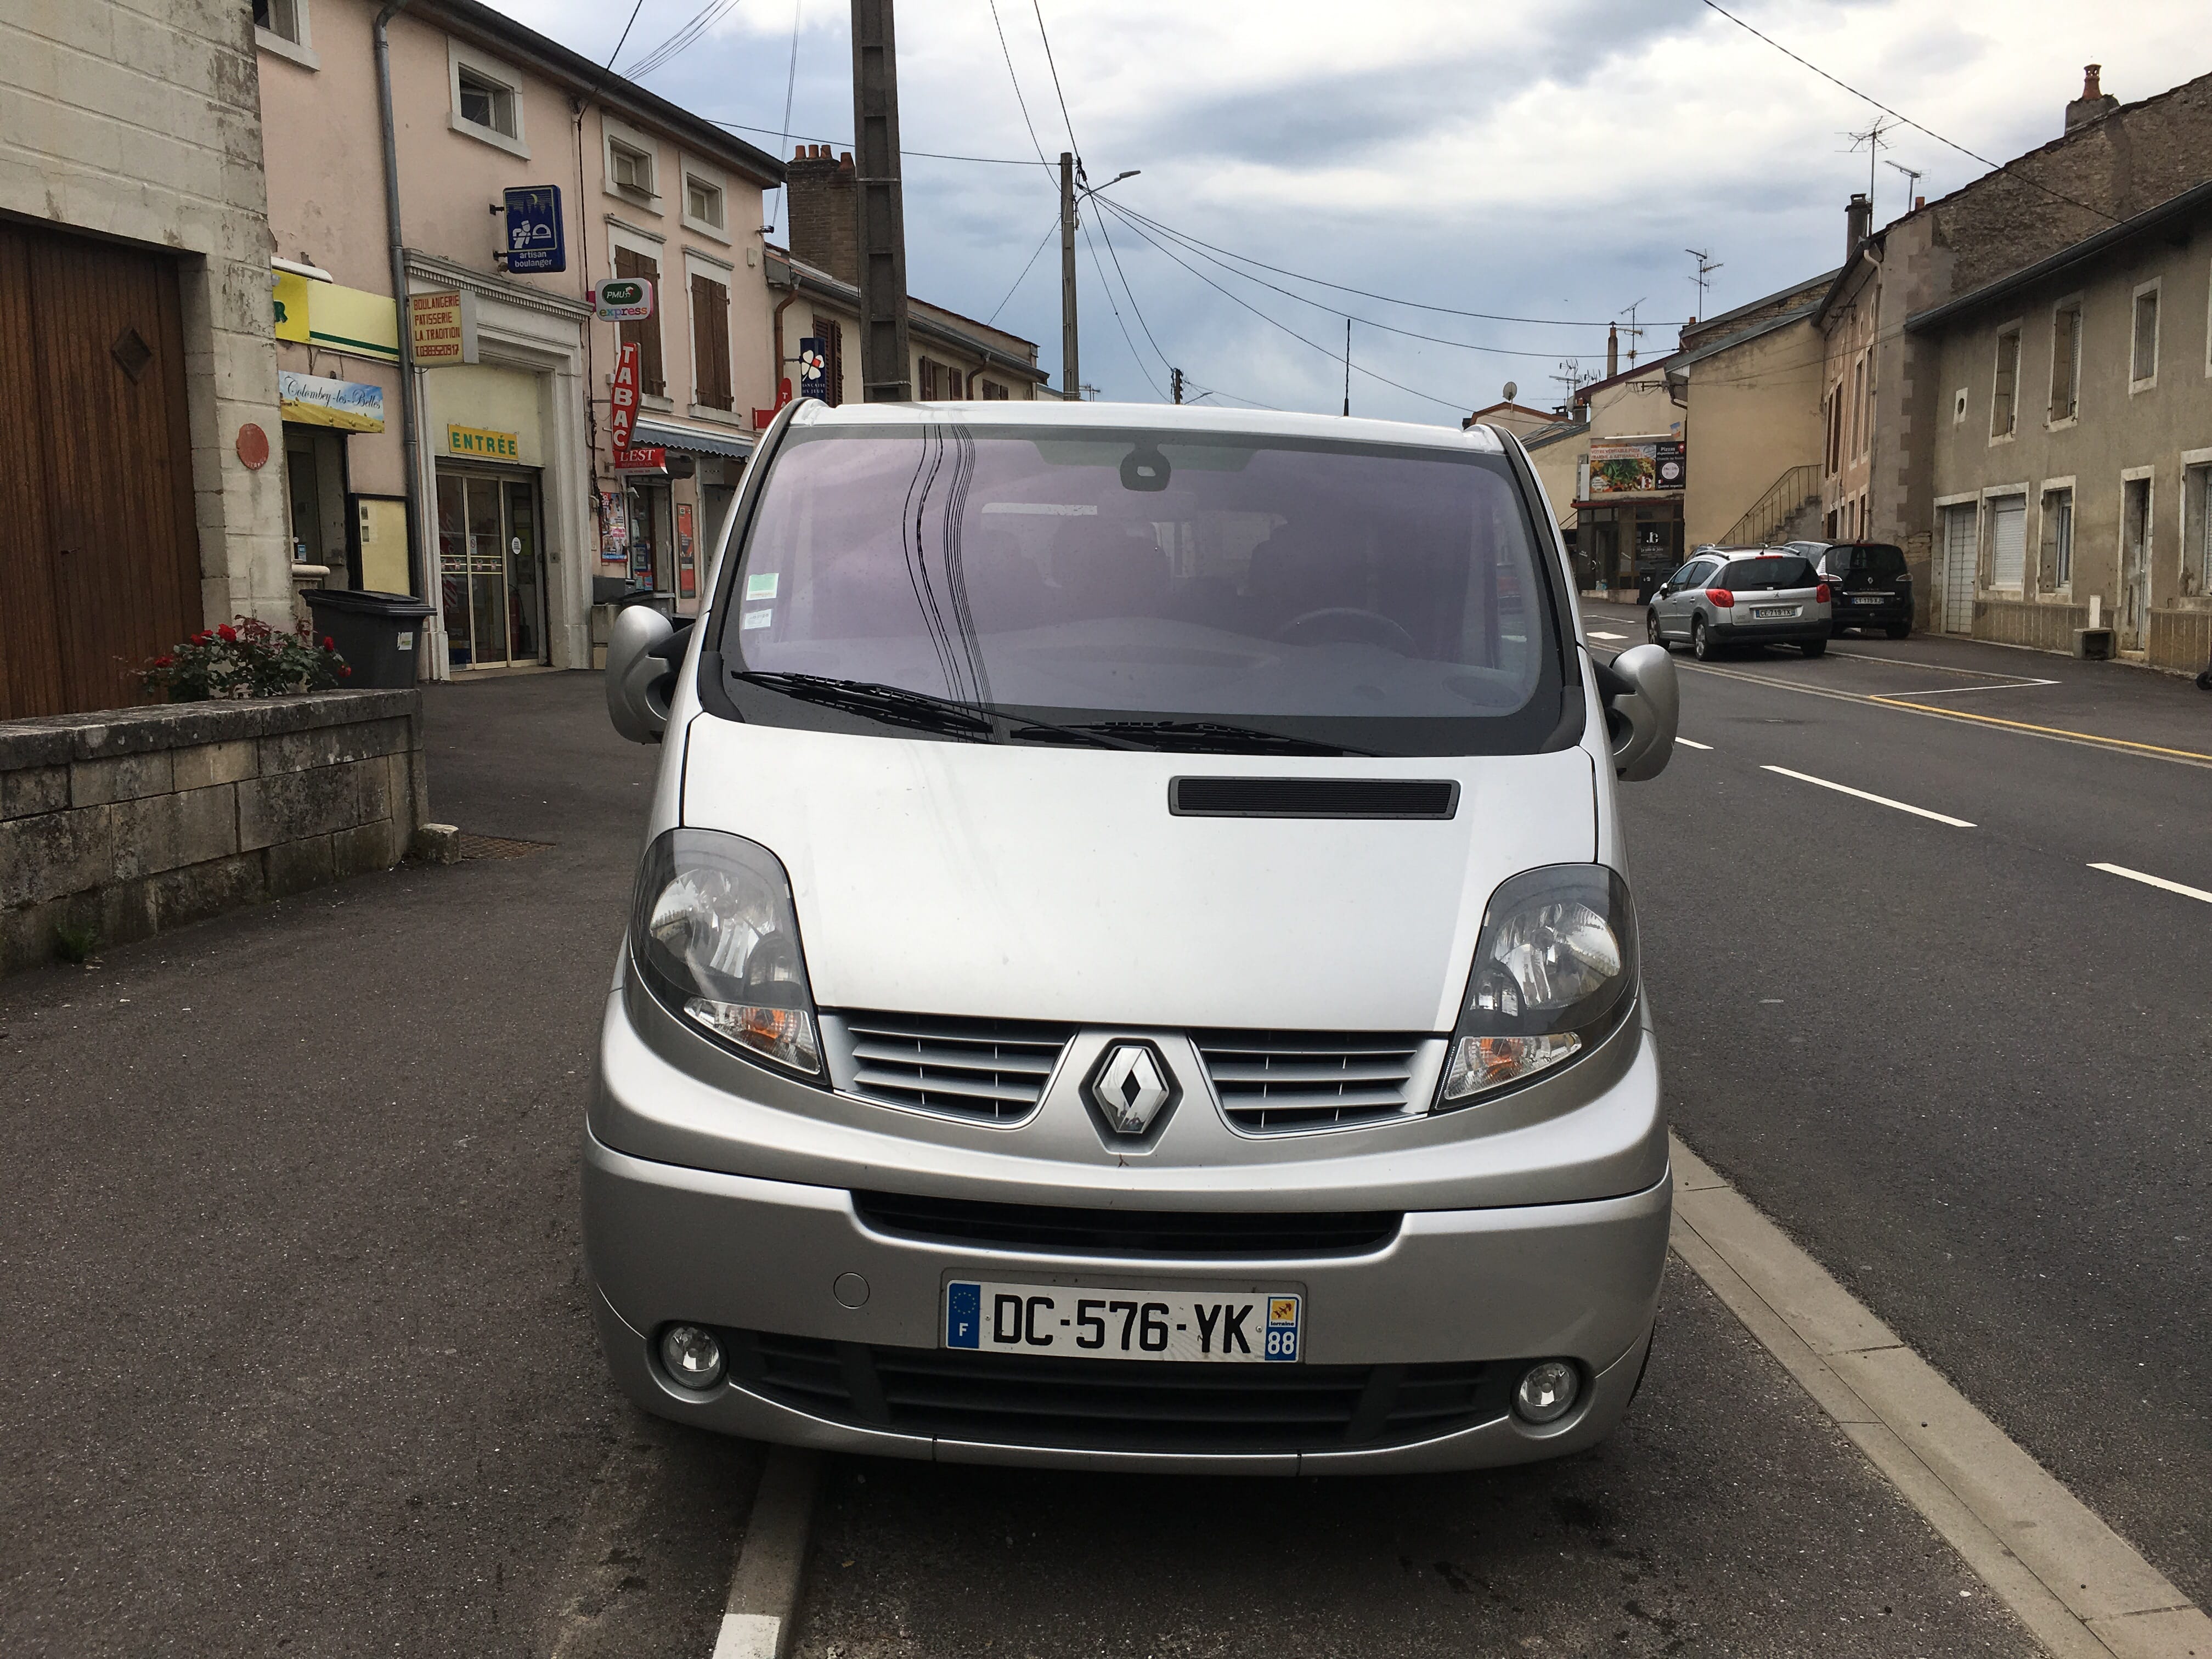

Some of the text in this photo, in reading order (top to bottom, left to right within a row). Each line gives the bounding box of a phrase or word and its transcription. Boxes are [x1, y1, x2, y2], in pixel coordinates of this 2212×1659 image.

[515, 259, 552, 267] boulanger
[414, 295, 459, 311] BOULANGERIE
[414, 312, 452, 326] PATISSERIE
[599, 307, 647, 319] express
[415, 327, 460, 341] LA TRADITION
[613, 346, 634, 447] TABAC
[452, 432, 516, 455] ENTRÉE
[619, 449, 655, 461] L'EST
[959, 1323, 968, 1336] F
[993, 1294, 1254, 1354] DC-576-YK
[1268, 1331, 1295, 1355] 88
